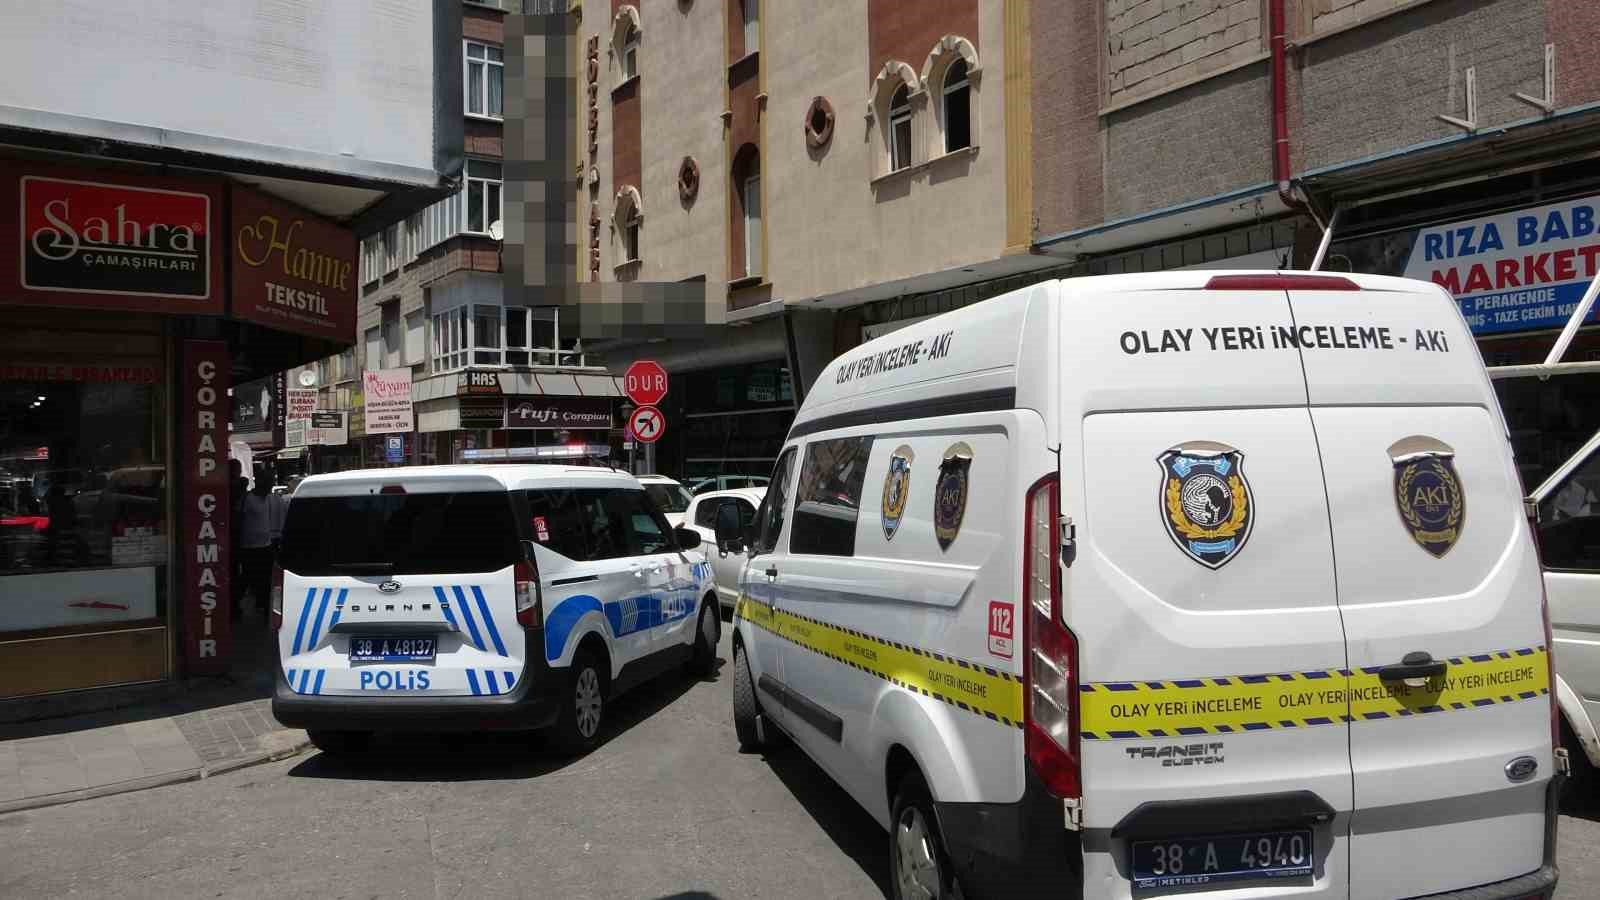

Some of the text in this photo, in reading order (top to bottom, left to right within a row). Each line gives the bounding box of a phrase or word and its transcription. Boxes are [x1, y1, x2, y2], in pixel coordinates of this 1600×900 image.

[32, 198, 198, 261] Sahra
[1424, 205, 1600, 262] RIZA BAB
[1431, 244, 1600, 296] MARKET
[1475, 288, 1556, 311] PERAKENDE
[1119, 328, 1193, 355] OLAY
[471, 372, 497, 386] HAS
[628, 375, 665, 392] DUR
[837, 360, 857, 385] OLAY
[197, 361, 217, 478] ÇORAP
[992, 607, 1011, 634] 112
[357, 640, 432, 655] 38 A 48137
[928, 670, 942, 682] OLAY
[1111, 703, 1150, 718] OLAY
[1279, 692, 1313, 708] OLAY
[1424, 676, 1455, 693] OLAY
[1162, 756, 1225, 767] CUSTOM
[1151, 835, 1304, 875] 38 A 4940
